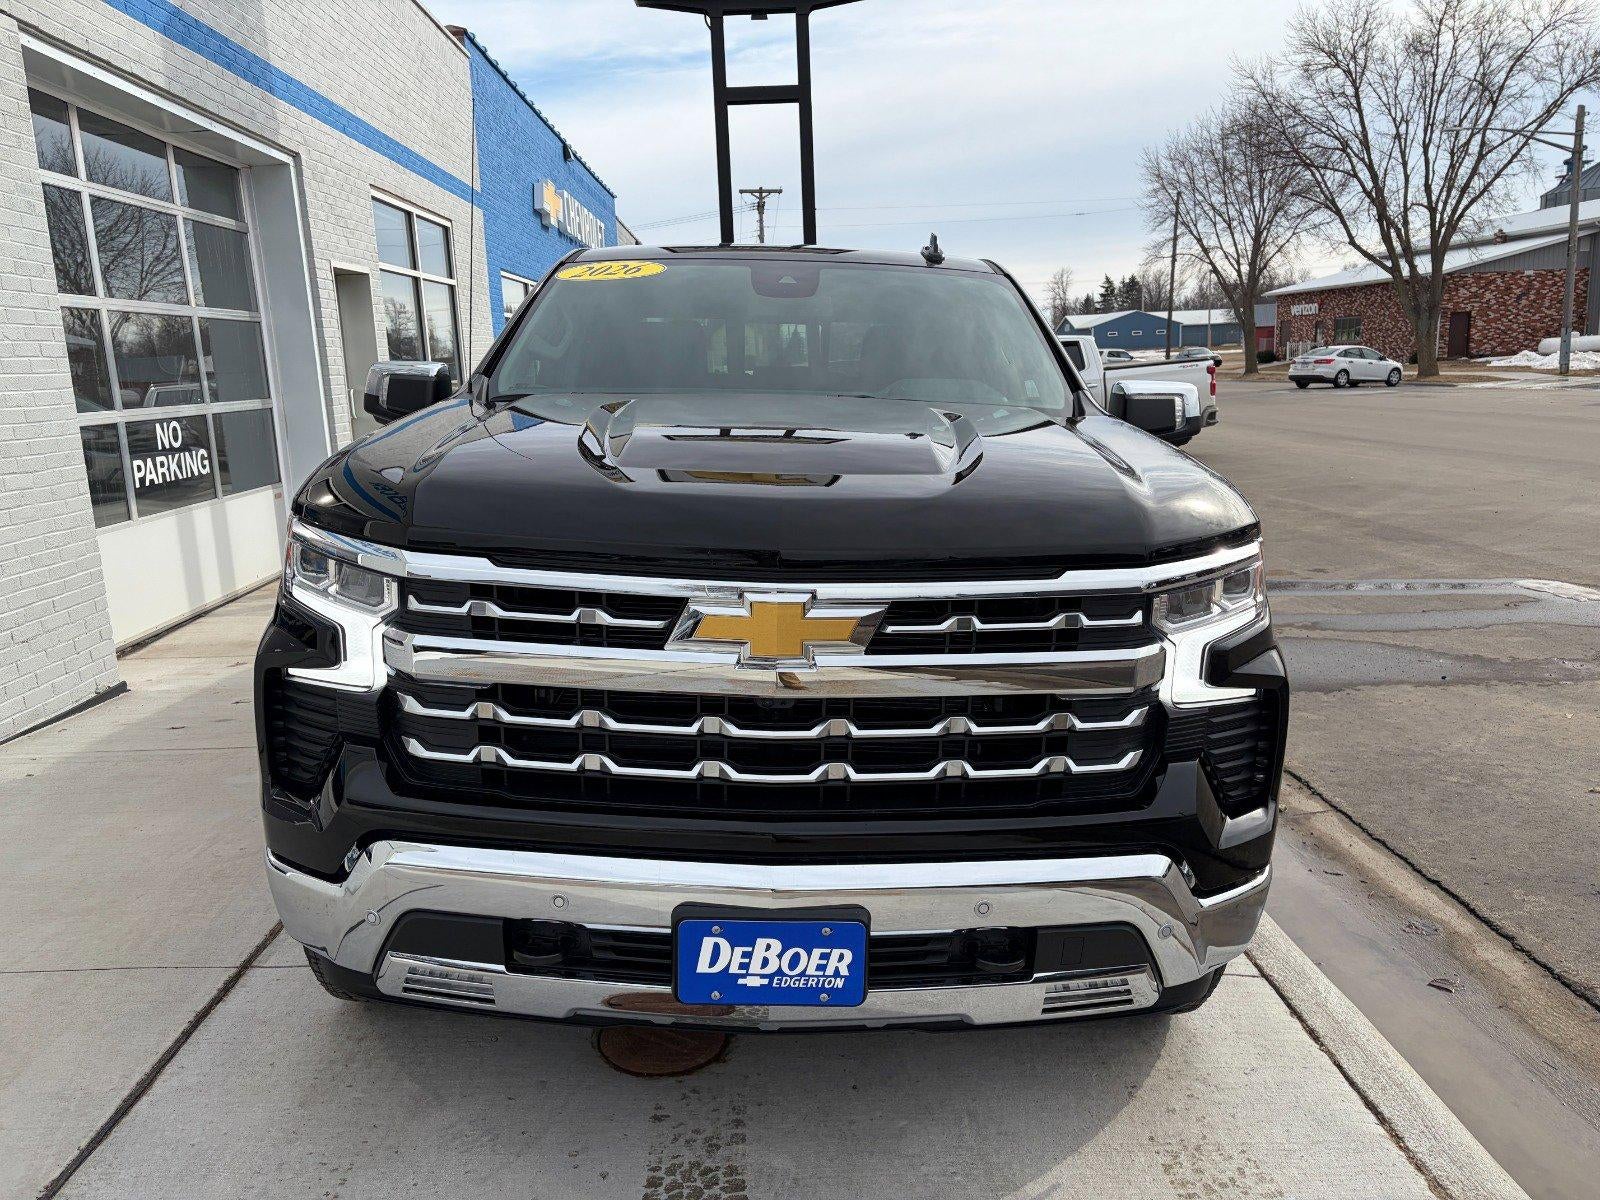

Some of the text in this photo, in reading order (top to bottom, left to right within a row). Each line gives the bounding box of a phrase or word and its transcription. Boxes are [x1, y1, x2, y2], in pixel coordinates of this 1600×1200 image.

[563, 189, 605, 248] CHEVROLET
[568, 264, 647, 279] 2026
[1290, 301, 1319, 316] verizon
[155, 420, 183, 450] NO
[132, 448, 211, 489] PARKING
[772, 976, 845, 989] EDGERTON
